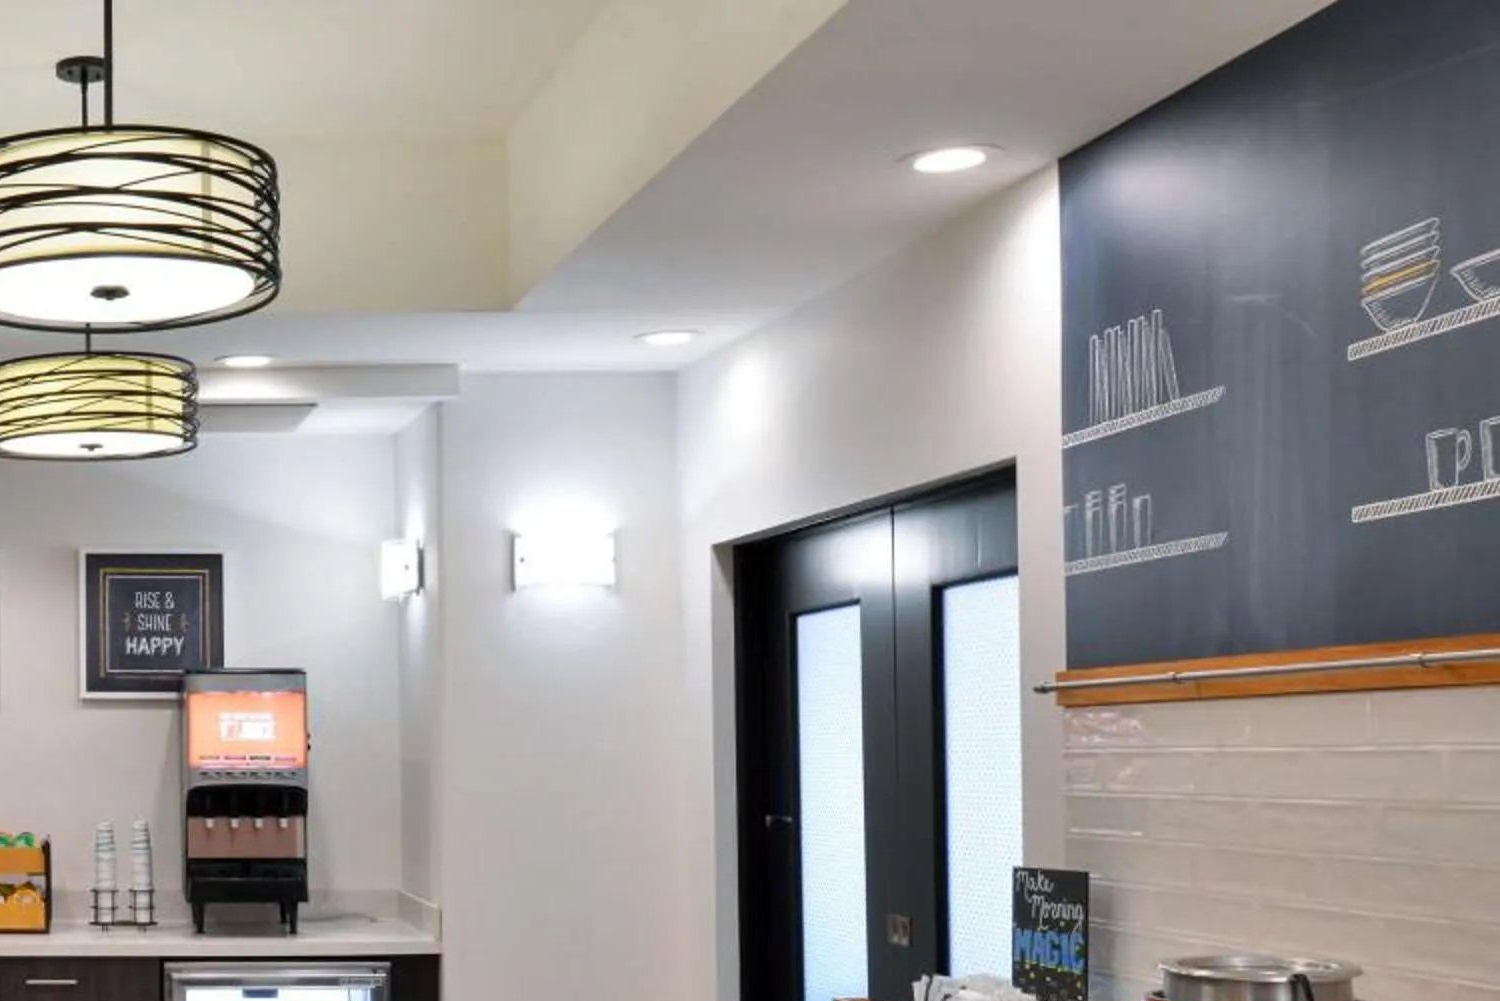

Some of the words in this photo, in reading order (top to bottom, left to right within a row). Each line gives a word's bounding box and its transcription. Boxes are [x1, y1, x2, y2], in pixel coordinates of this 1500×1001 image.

[134, 591, 161, 609] RISE
[164, 591, 175, 609] &
[137, 613, 172, 631] SHINE
[125, 635, 185, 656] HAPPY
[1015, 870, 1054, 902] Make
[1031, 894, 1084, 931] Morning
[1015, 928, 1085, 973] MAGIC
